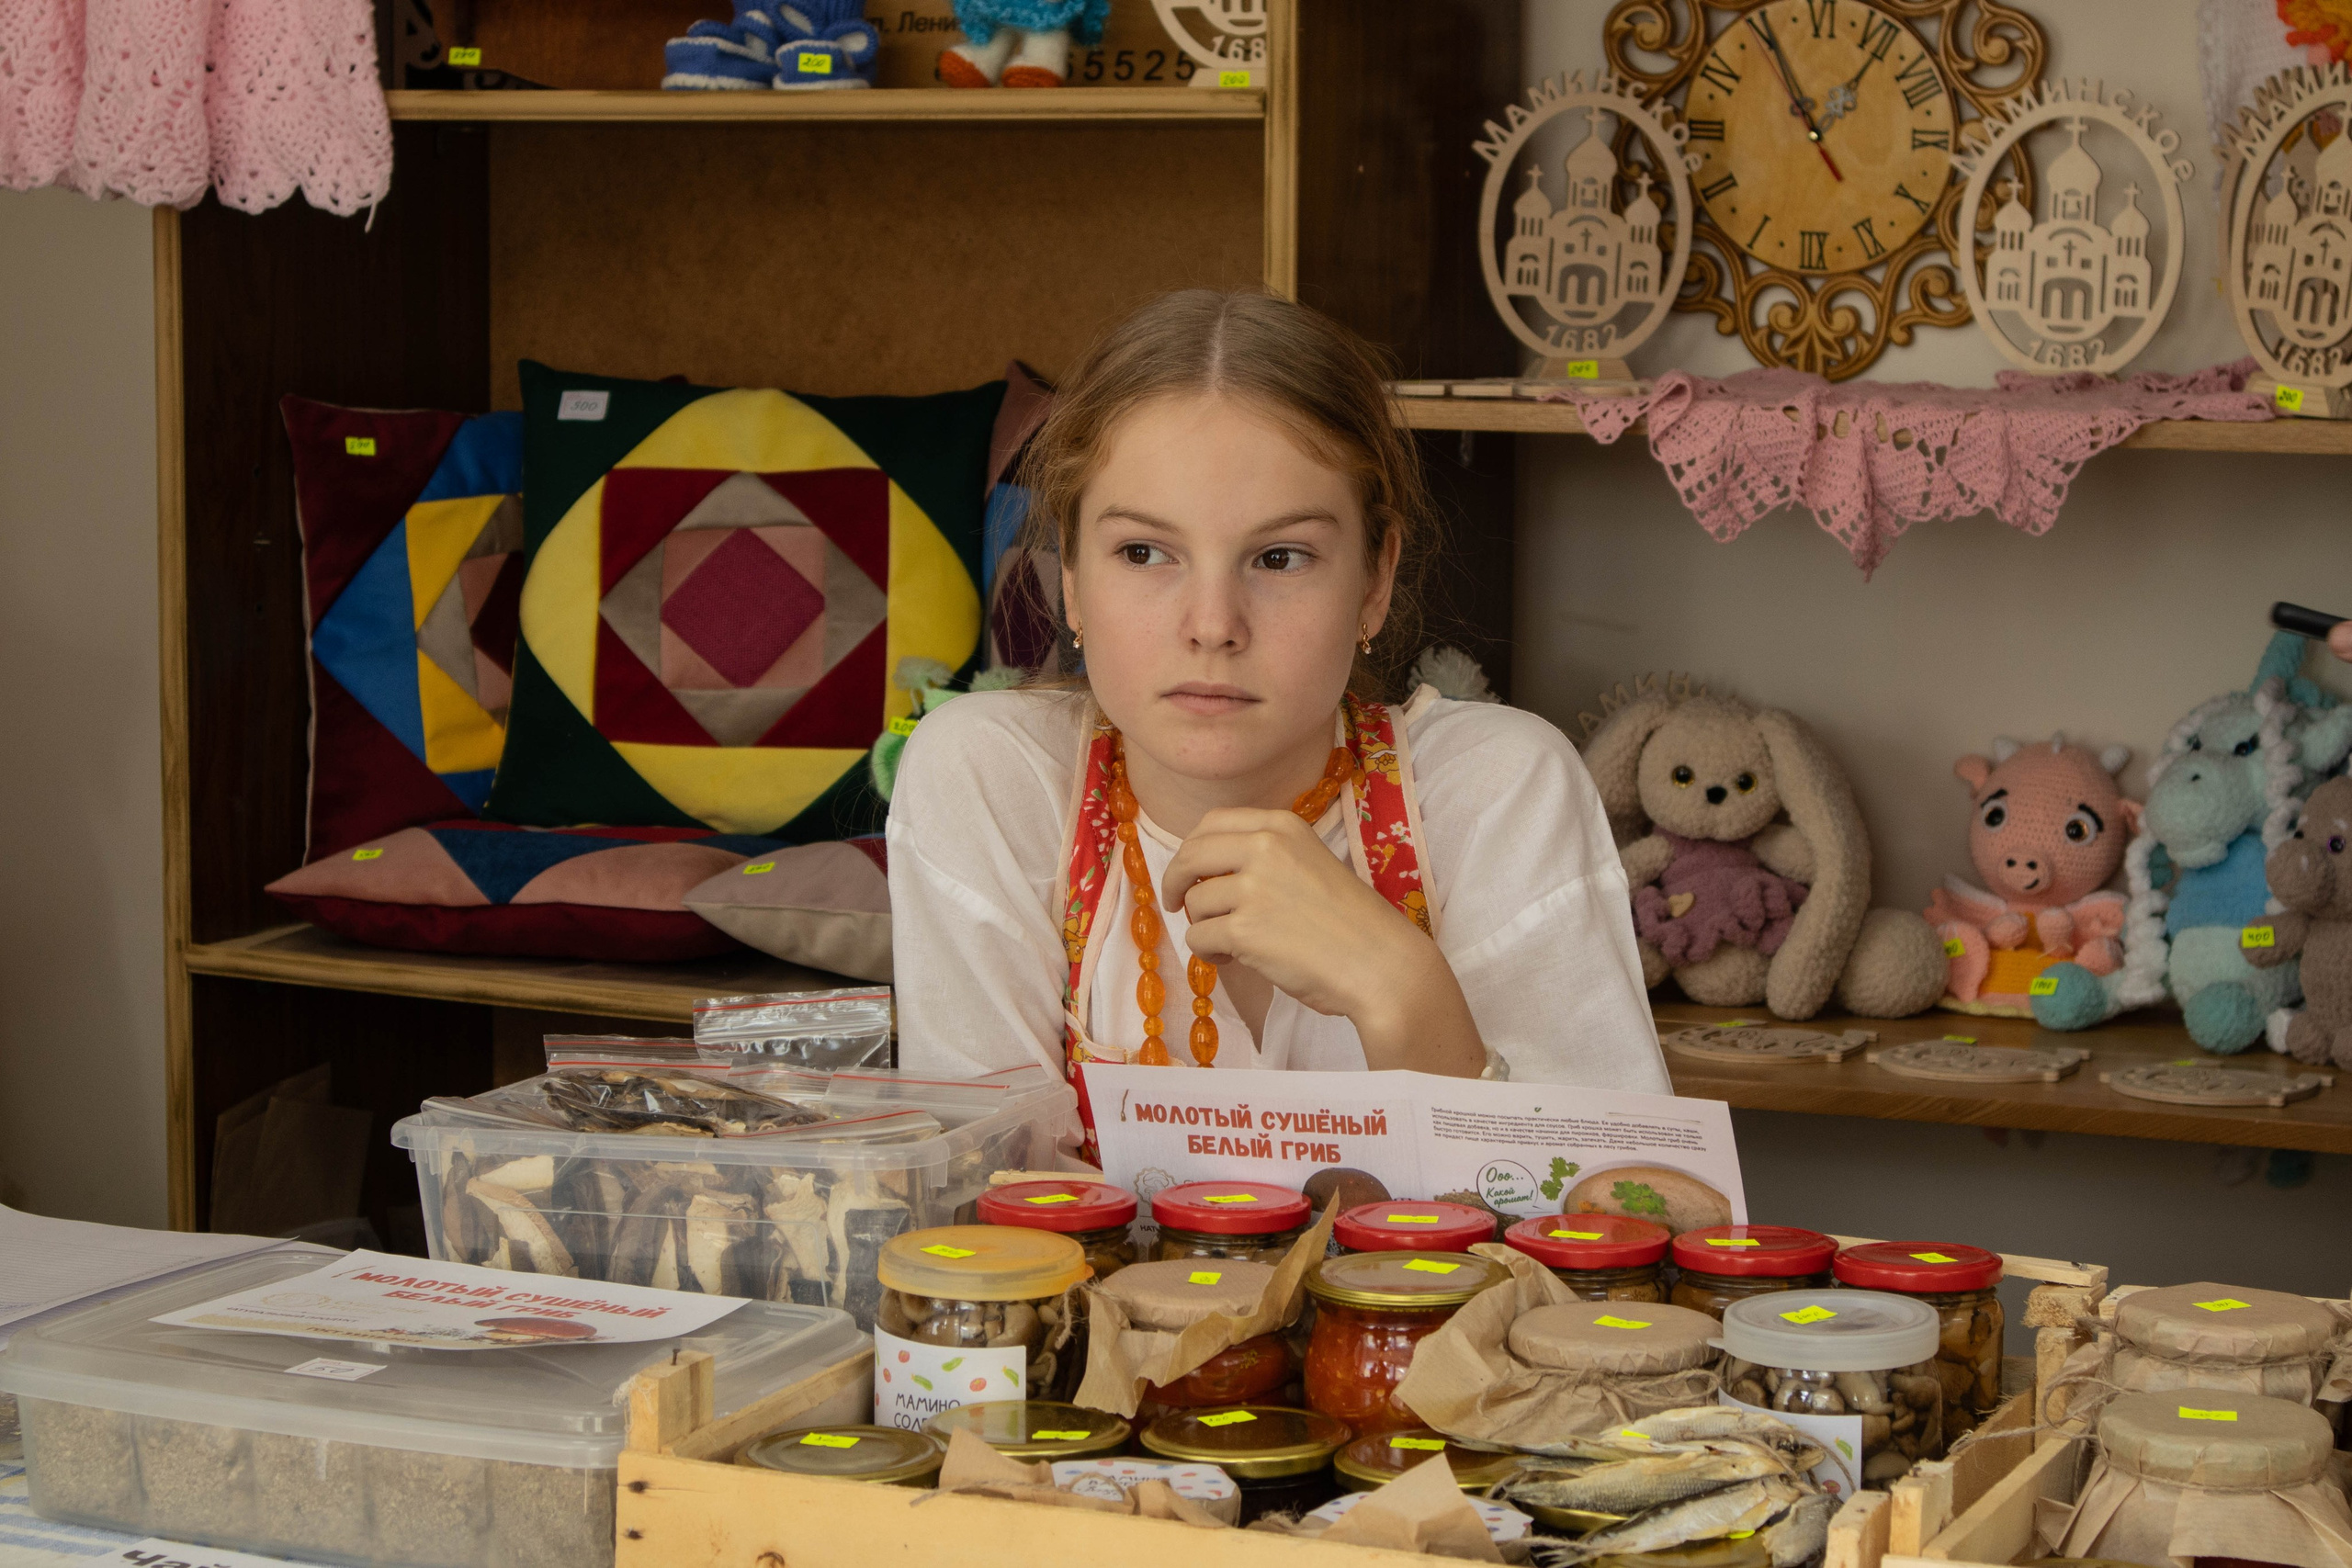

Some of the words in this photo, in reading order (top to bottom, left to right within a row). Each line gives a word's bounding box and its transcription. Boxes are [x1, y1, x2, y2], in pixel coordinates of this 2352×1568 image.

[1545, 323, 1619, 353] 1682
[2029, 338, 2108, 368] 1682
[1135, 1103, 1253, 1130] МОЛОТЫЙ
[1261, 1108, 1387, 1136] СУШЁНЫЙ
[1187, 1133, 1273, 1159] БЕЛЫЙ
[1280, 1140, 1341, 1164] ГРИБ
[1486, 1167, 1523, 1183] Ооо...
[1486, 1187, 1515, 1199] Какой
[1494, 1190, 1534, 1209] аромат!
[351, 1272, 510, 1300] МОЛОТЫЙ
[504, 1292, 673, 1320] СУШЁНЫЙ
[380, 1289, 499, 1310] БЕЛЫЙ
[495, 1303, 584, 1319] ГРИБ
[895, 1393, 961, 1413] МАМИНО
